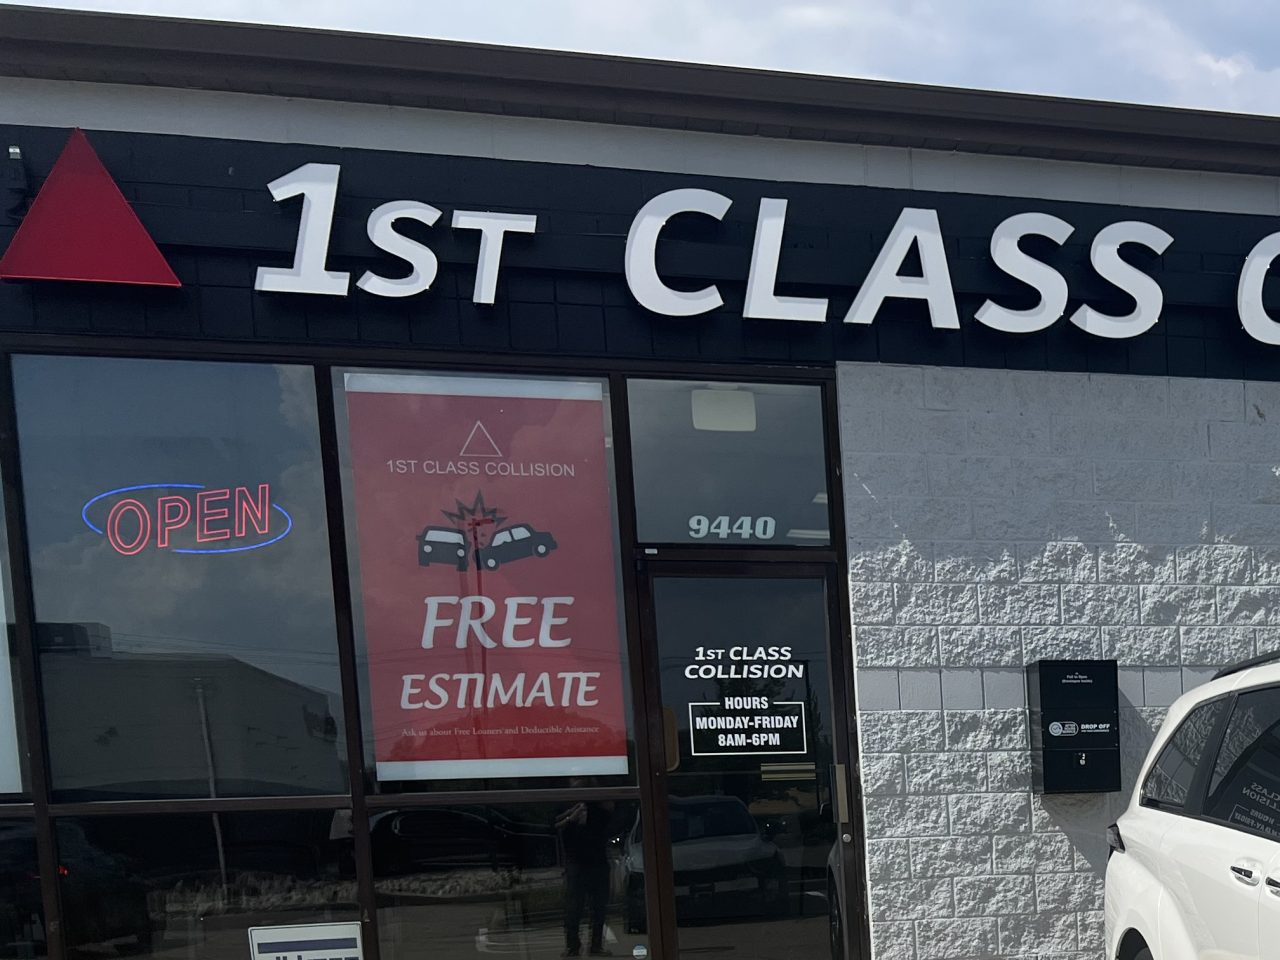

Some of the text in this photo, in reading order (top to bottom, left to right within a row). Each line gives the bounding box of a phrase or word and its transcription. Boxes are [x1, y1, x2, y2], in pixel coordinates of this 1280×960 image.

[254, 162, 538, 305] 1ST
[624, 187, 1175, 340] CLASS
[386, 459, 576, 477] 1ST CLASS COLLISION
[107, 484, 269, 556] OPEN
[688, 515, 777, 540] 9440
[421, 595, 576, 649] FREE
[695, 646, 792, 661] 1ST CLASS
[684, 664, 804, 679] COLLISION
[401, 671, 601, 710] ESTIMATE
[724, 696, 769, 710] HOURS
[695, 715, 799, 730] MONDAY-FRIDAY
[401, 728, 417, 737] Ask
[430, 728, 452, 736] about
[454, 727, 471, 736] Free
[504, 726, 519, 735] and
[521, 725, 562, 735] Deductible
[718, 733, 781, 747] 8AM-6PM
